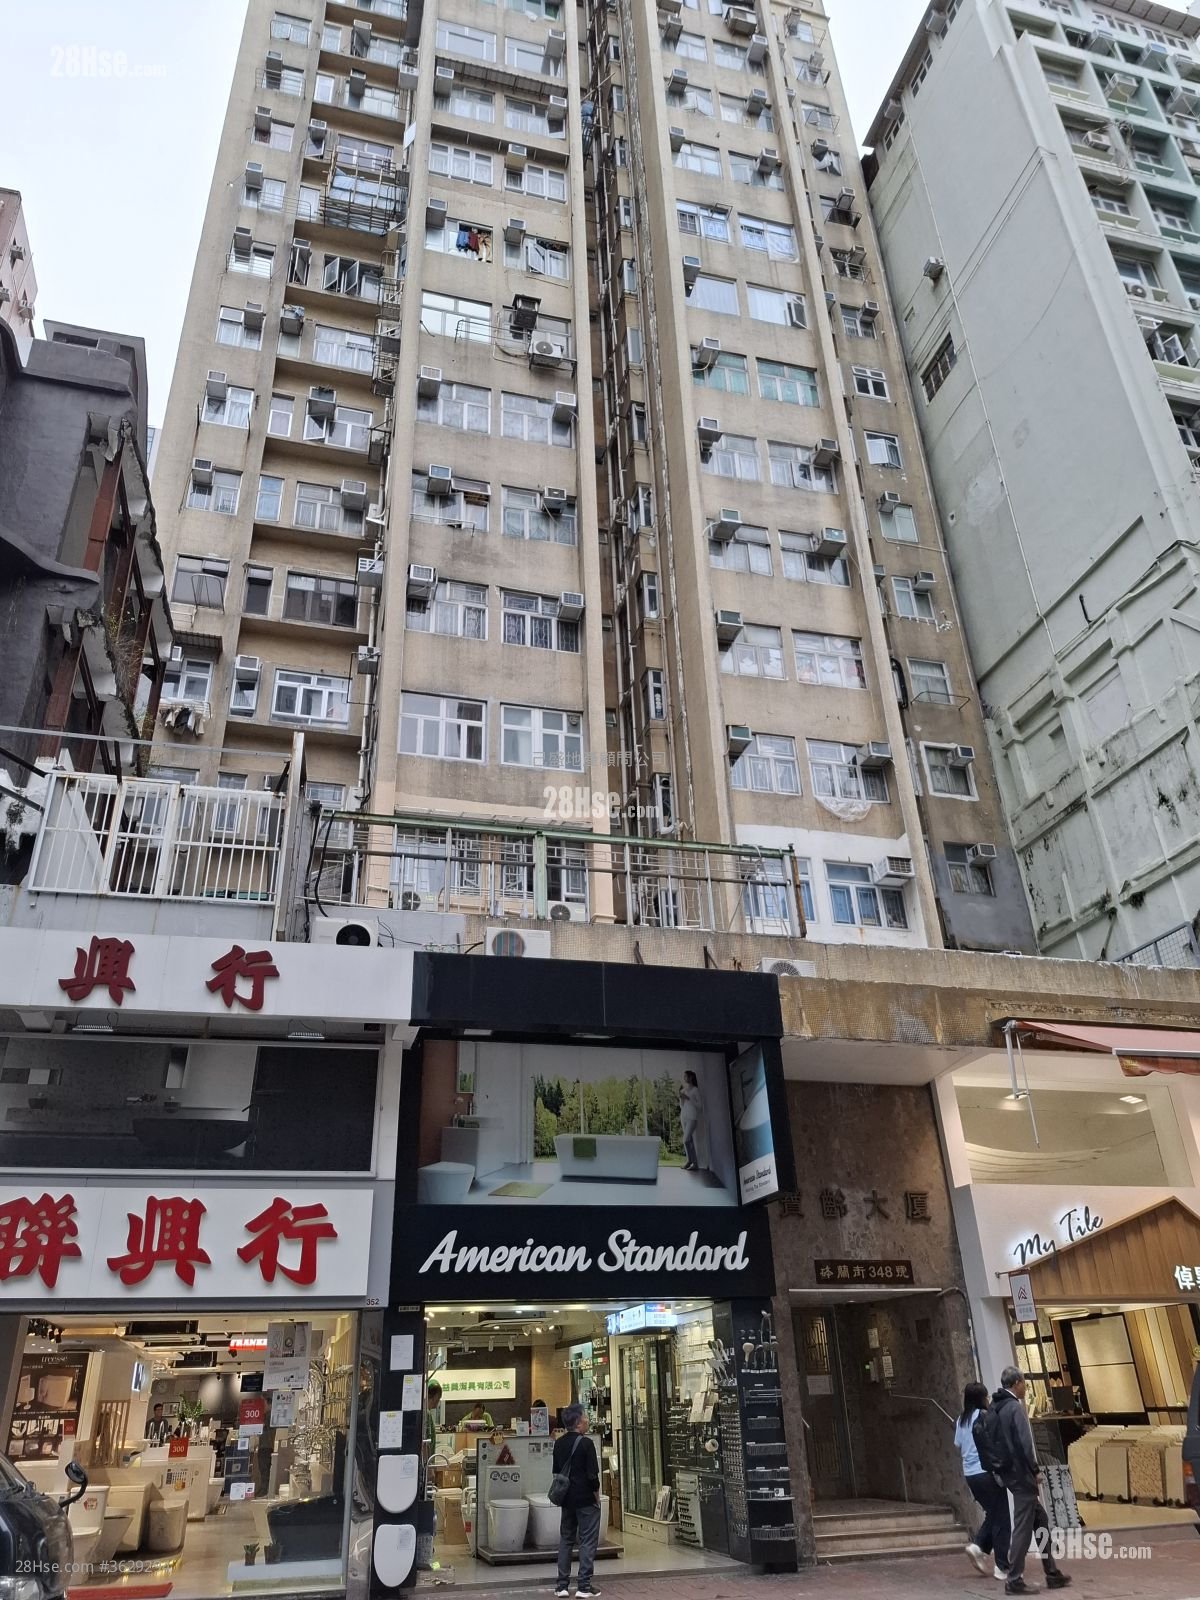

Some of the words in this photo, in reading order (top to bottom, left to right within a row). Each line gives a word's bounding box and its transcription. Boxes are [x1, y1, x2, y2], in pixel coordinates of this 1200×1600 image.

[58, 935, 280, 1011] 興行
[0, 1192, 338, 1289] 聯興行
[418, 1230, 592, 1274] American
[597, 1229, 750, 1273] Standard
[1013, 1233, 1058, 1267] My
[1059, 1205, 1104, 1242] Tile
[1174, 1265, 1200, 1290] 倬
[366, 1298, 380, 1306] 352
[244, 1409, 261, 1418] 300
[172, 1445, 185, 1453] 300
